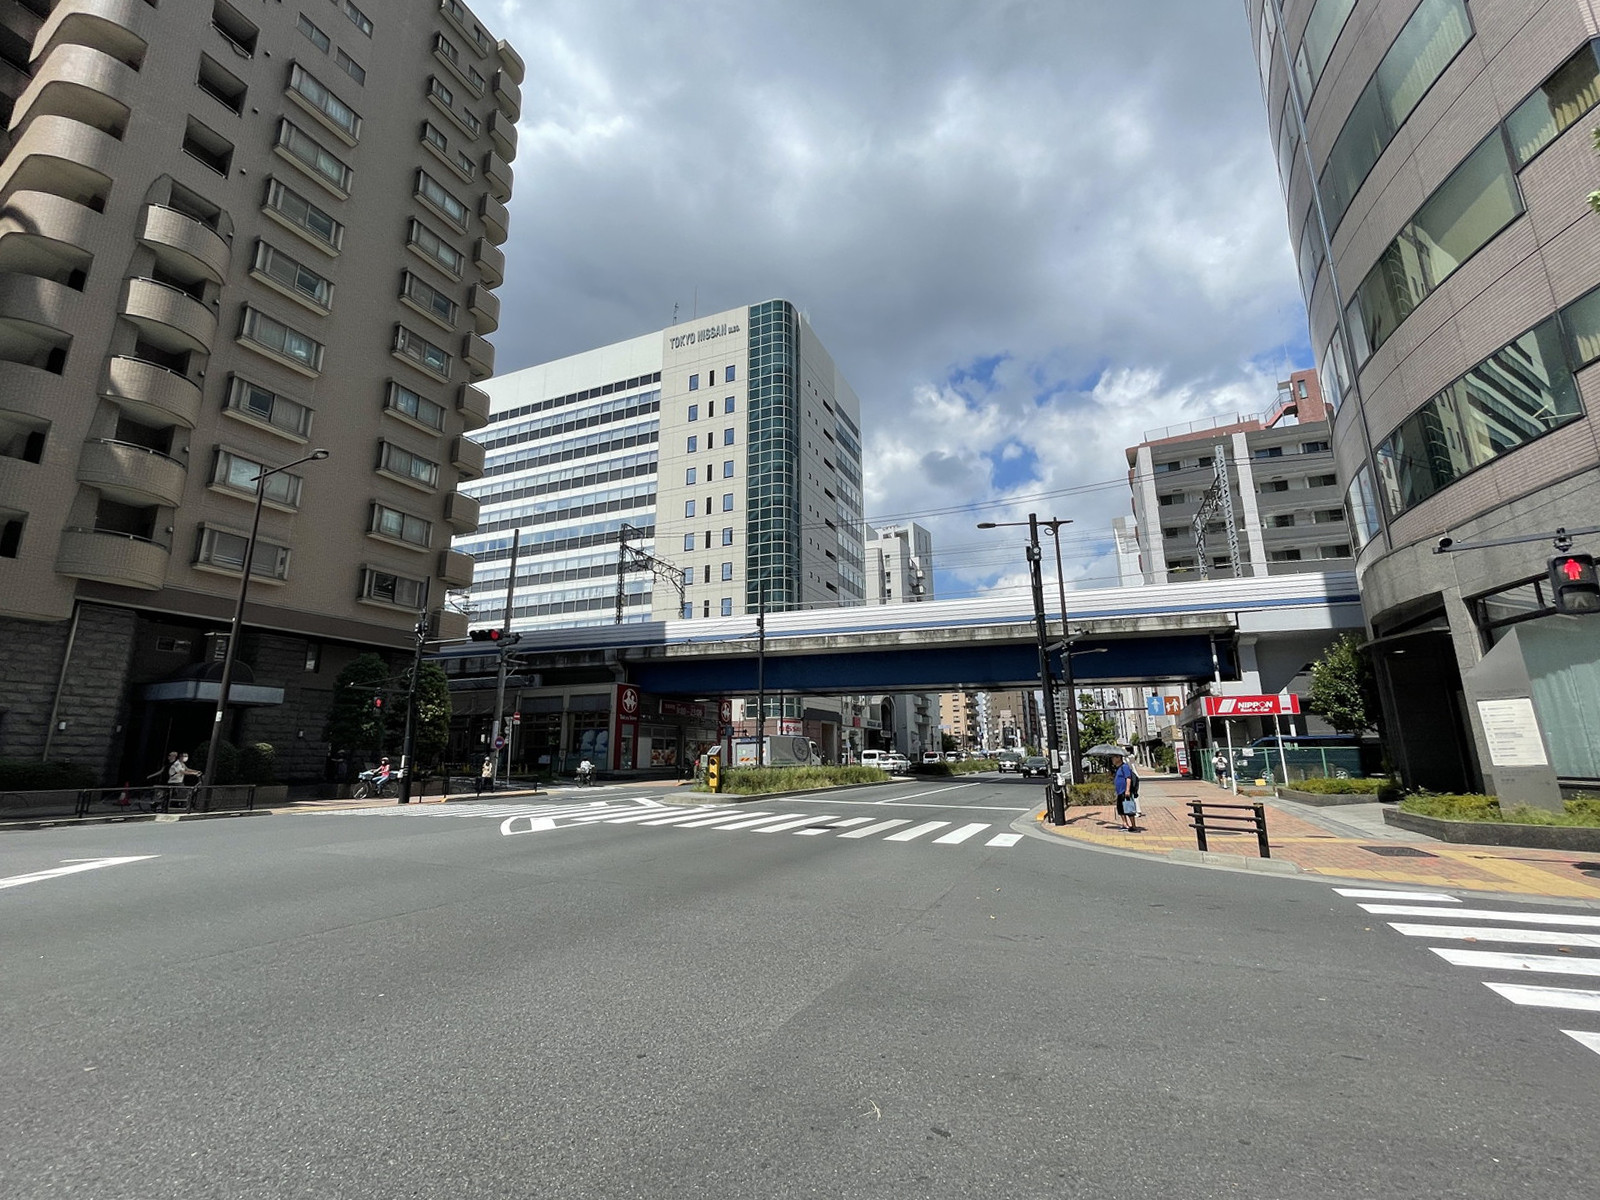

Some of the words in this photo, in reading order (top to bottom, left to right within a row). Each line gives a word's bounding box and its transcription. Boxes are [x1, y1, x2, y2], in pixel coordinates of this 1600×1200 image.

[669, 332, 695, 349] TOKYO
[697, 324, 727, 342] NISSAN
[1238, 701, 1273, 709] NIPPON
